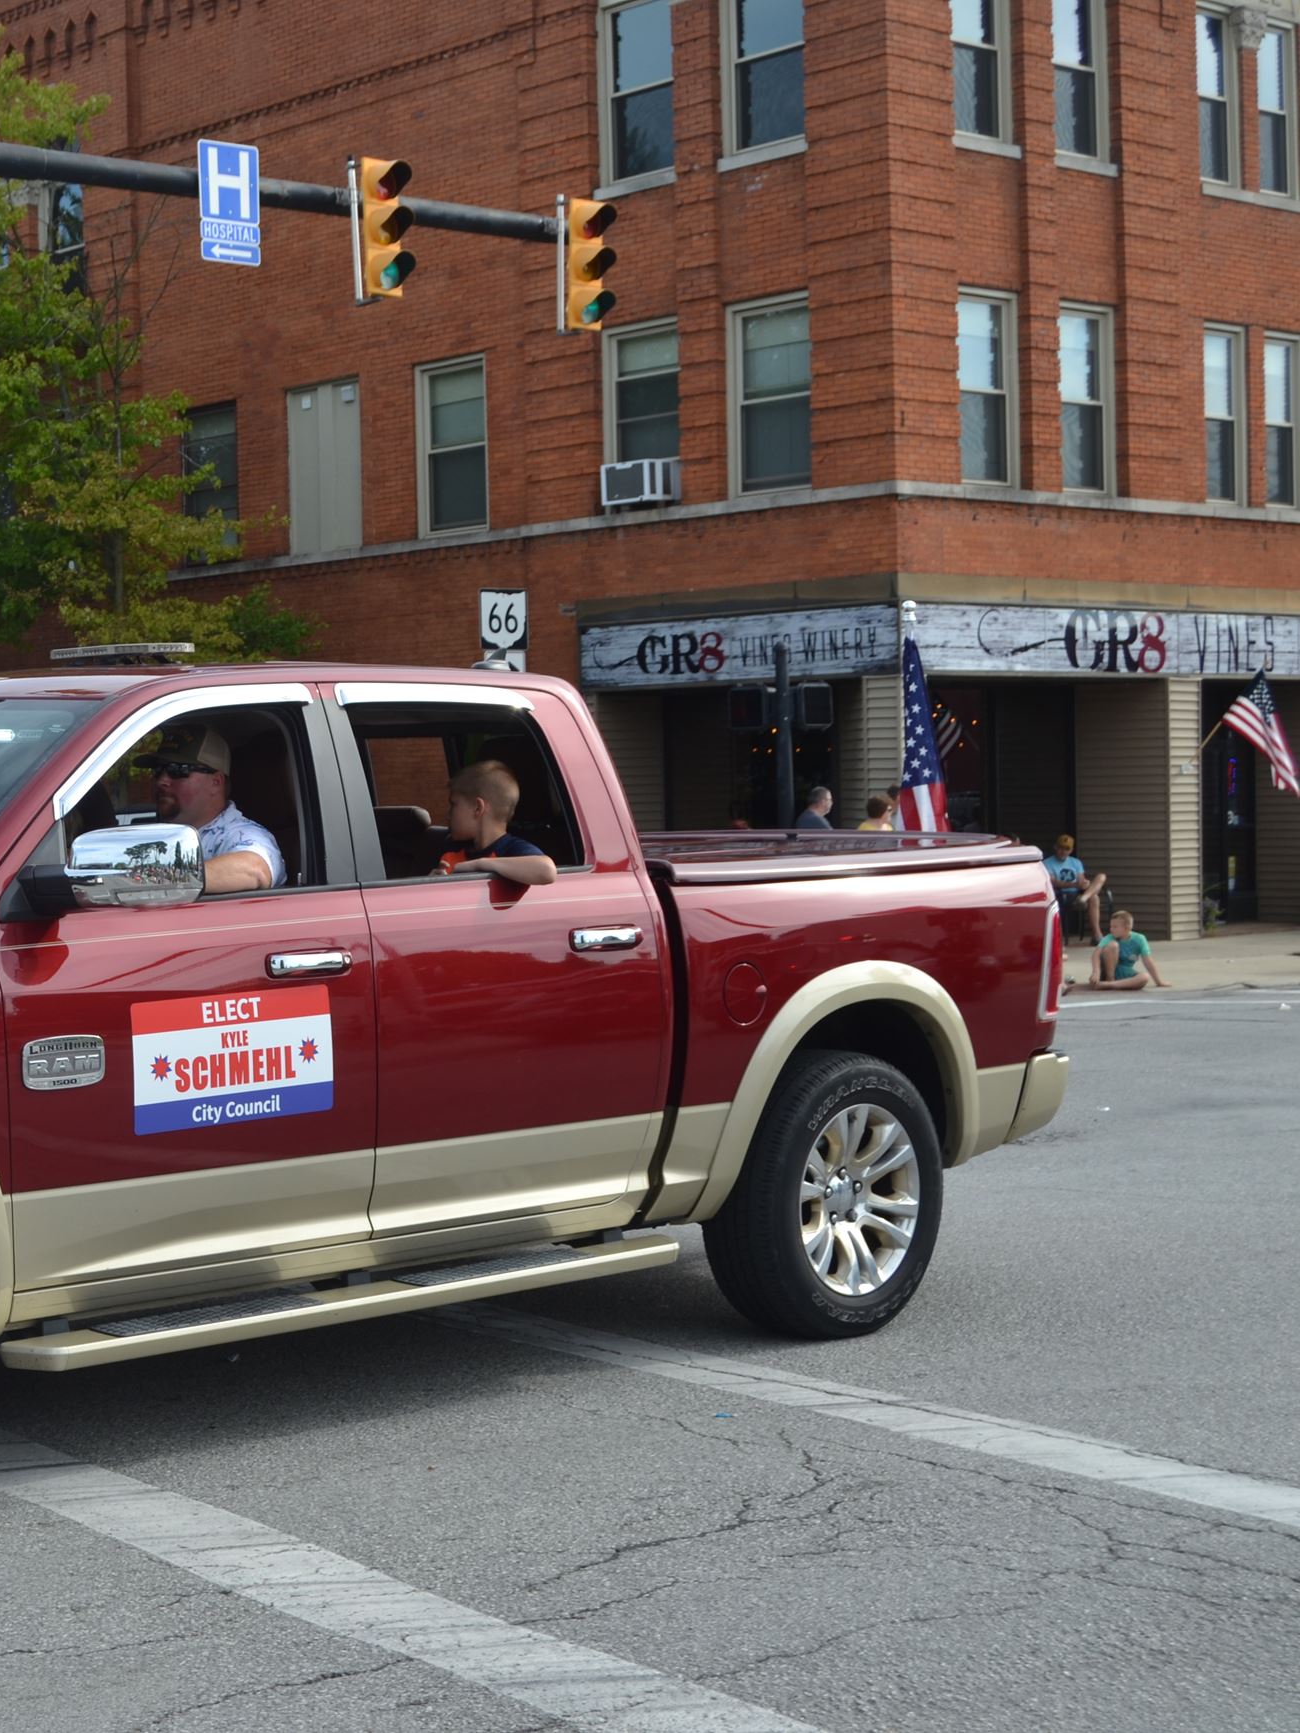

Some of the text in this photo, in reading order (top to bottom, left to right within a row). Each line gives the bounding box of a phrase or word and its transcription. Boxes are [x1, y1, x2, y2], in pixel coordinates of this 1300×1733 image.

[207, 146, 250, 219] H
[204, 221, 257, 243] HOSPITAL
[488, 602, 519, 634] 66
[636, 631, 725, 675] GR8
[802, 626, 877, 664] WINERY
[1063, 608, 1275, 674] GR8 VINES
[201, 997, 261, 1024] ELECT
[220, 1030, 249, 1049] KYLE
[28, 1053, 100, 1077] RAM
[174, 1045, 297, 1093] SCHMEHL
[52, 1078, 78, 1087] 1500
[192, 1094, 281, 1124] City Council
